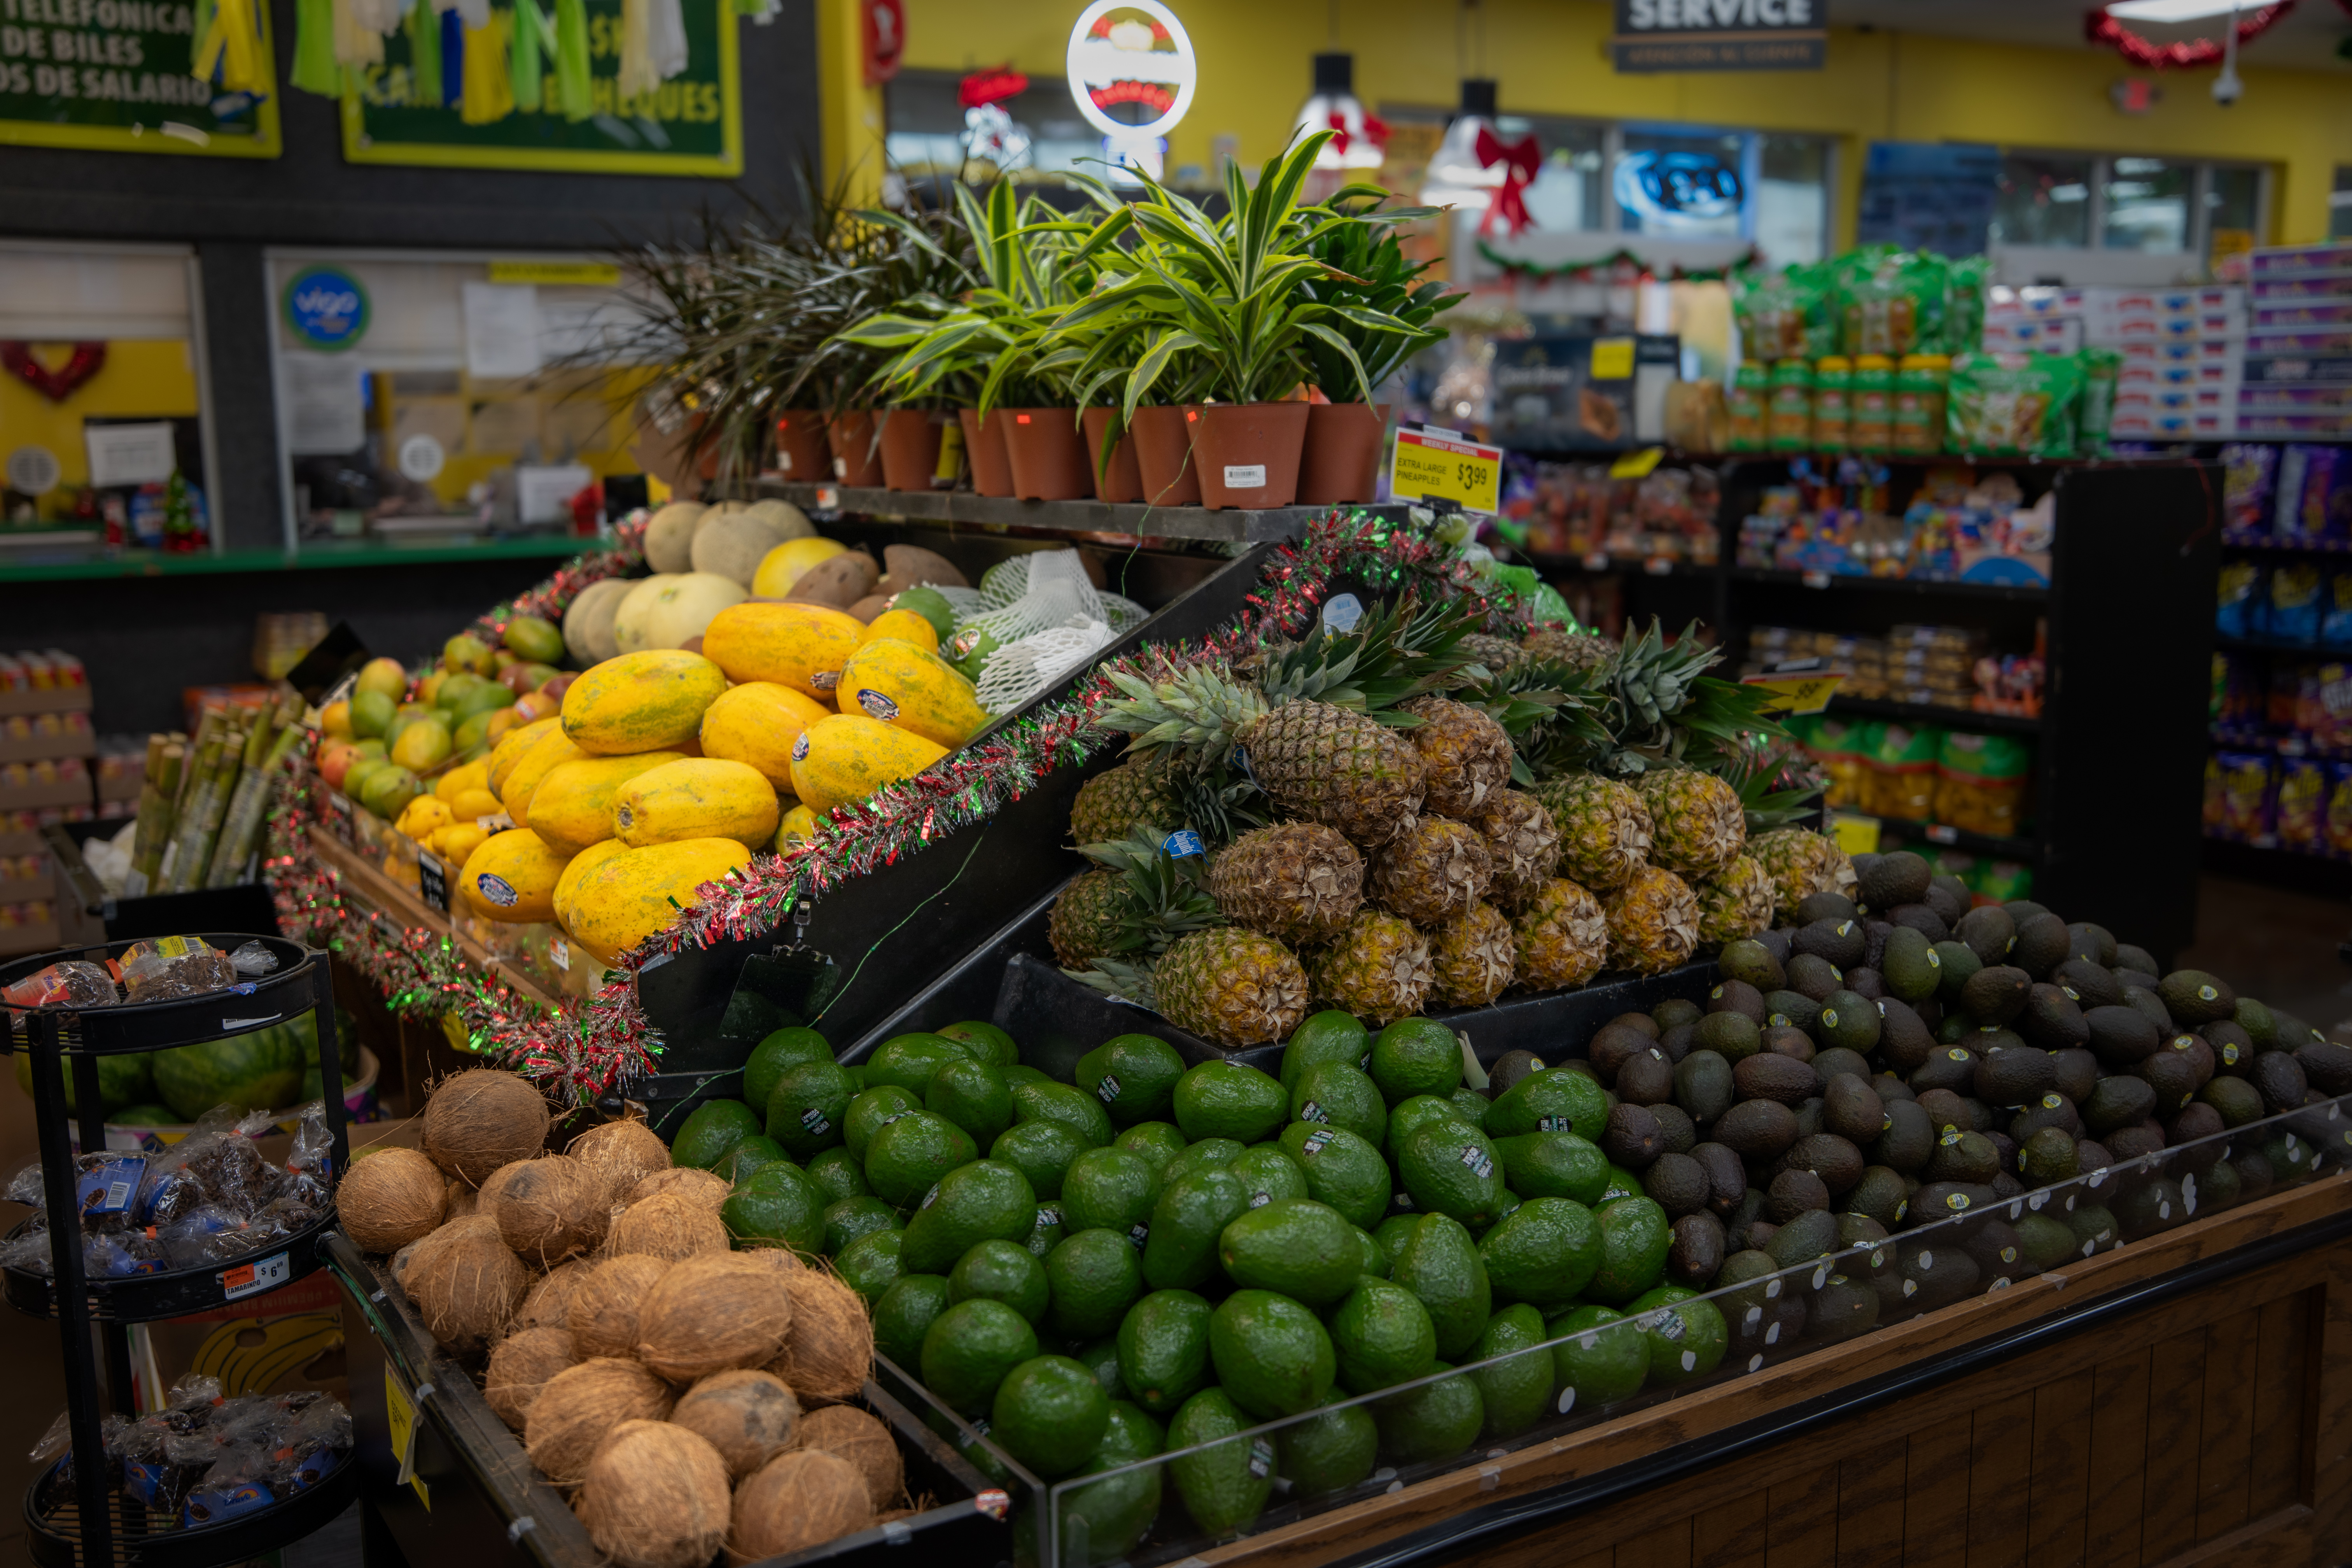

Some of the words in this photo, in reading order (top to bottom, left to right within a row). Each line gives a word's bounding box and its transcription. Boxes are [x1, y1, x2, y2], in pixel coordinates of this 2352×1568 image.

[1628, 0, 1813, 30] SERVICE
[2, 24, 47, 59] DE
[51, 29, 145, 67] BILES
[34, 64, 79, 98] DE
[81, 68, 213, 107] SALARIO
[1421, 438, 1449, 451] WEEKLY
[1450, 444, 1479, 456] SPECIAL
[1397, 457, 1421, 470] EXTRA
[1423, 462, 1447, 474] LARGE
[1396, 470, 1440, 486] PINEAPPLES
[1172, 831, 1195, 856] Chiquita
[1102, 1082, 1115, 1097] AVOCADO
[1106, 1075, 1120, 1092] CARRERA
[801, 1109, 818, 1121] CARRERA
[807, 1115, 823, 1129] AVOCADO
[227, 1279, 261, 1295] TAMARINDO
[1661, 1315, 1676, 1332] AVOCADO
[1668, 1323, 1685, 1339] CARRERA
[391, 1400, 406, 1429] COCONUT
[223, 1492, 251, 1506] Bravo
[225, 1496, 261, 1509] SUPERMARKETS
[227, 1508, 247, 1517] WHOLE
